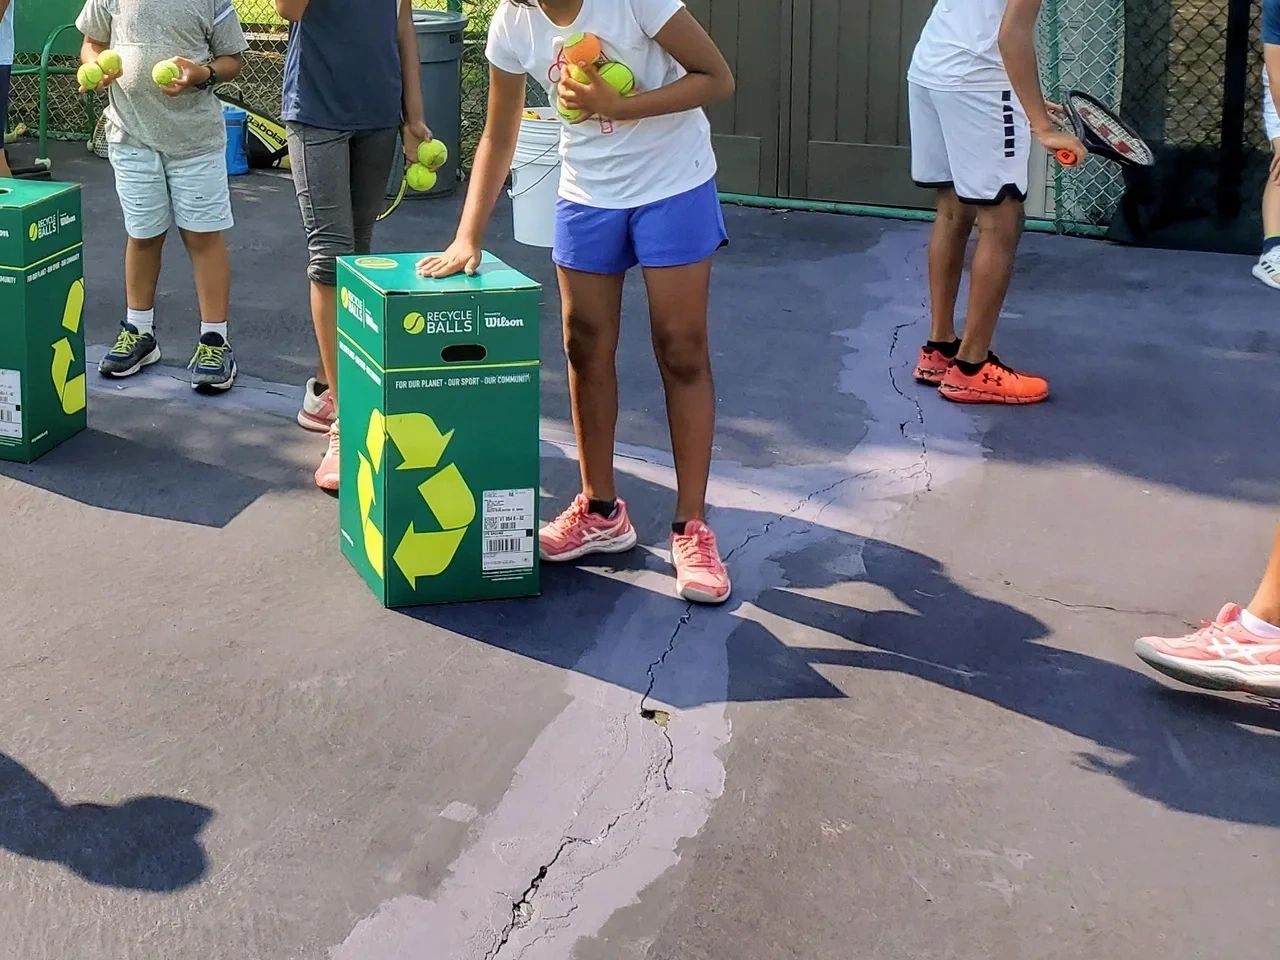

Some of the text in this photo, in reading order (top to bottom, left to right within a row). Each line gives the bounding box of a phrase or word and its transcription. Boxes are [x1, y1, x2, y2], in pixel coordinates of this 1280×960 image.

[38, 223, 56, 239] BALLS
[427, 310, 472, 321] RECYCLE
[484, 316, 524, 327] Wilson
[427, 320, 472, 334] BALLS
[395, 380, 407, 389] FOR
[421, 379, 443, 388] PLANET
[448, 378, 460, 386] OUR
[461, 377, 479, 386] SPORT
[484, 376, 496, 384] OUR
